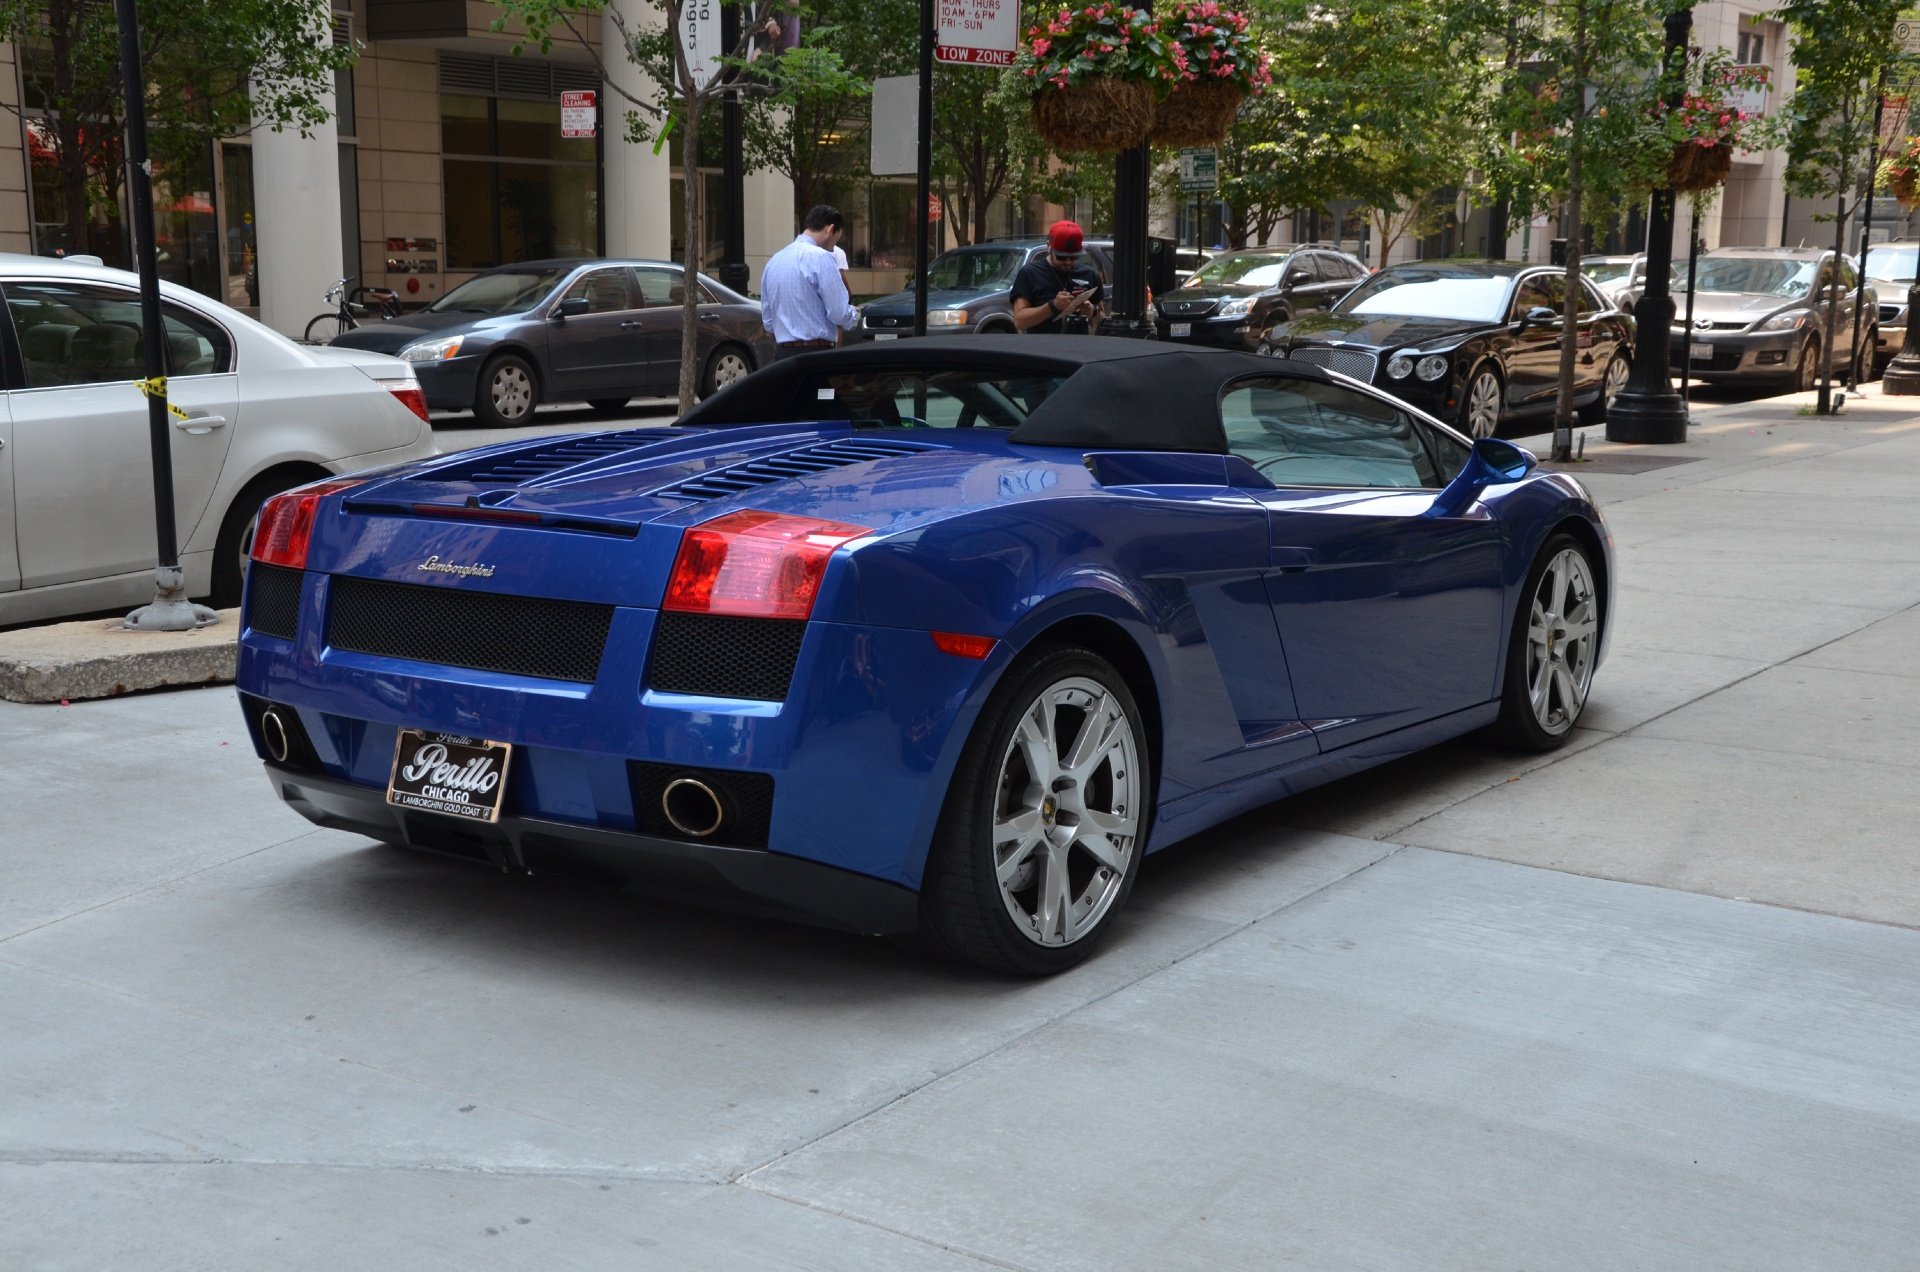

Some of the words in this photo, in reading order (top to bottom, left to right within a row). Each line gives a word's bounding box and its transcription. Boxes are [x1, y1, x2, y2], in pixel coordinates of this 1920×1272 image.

[972, 0, 1001, 10] THURS
[941, 18, 956, 28] FRI
[964, 20, 983, 30] SUN
[941, 47, 969, 60] TOW
[976, 50, 1010, 64] ZONE
[417, 555, 496, 578] Lamborghini
[436, 734, 472, 745] Perillo
[402, 743, 499, 794] Perillo
[421, 784, 470, 804] CHICAGO
[402, 795, 443, 810] LAMBORGHINI
[443, 804, 461, 814] GOLD
[460, 806, 481, 817] COAST
